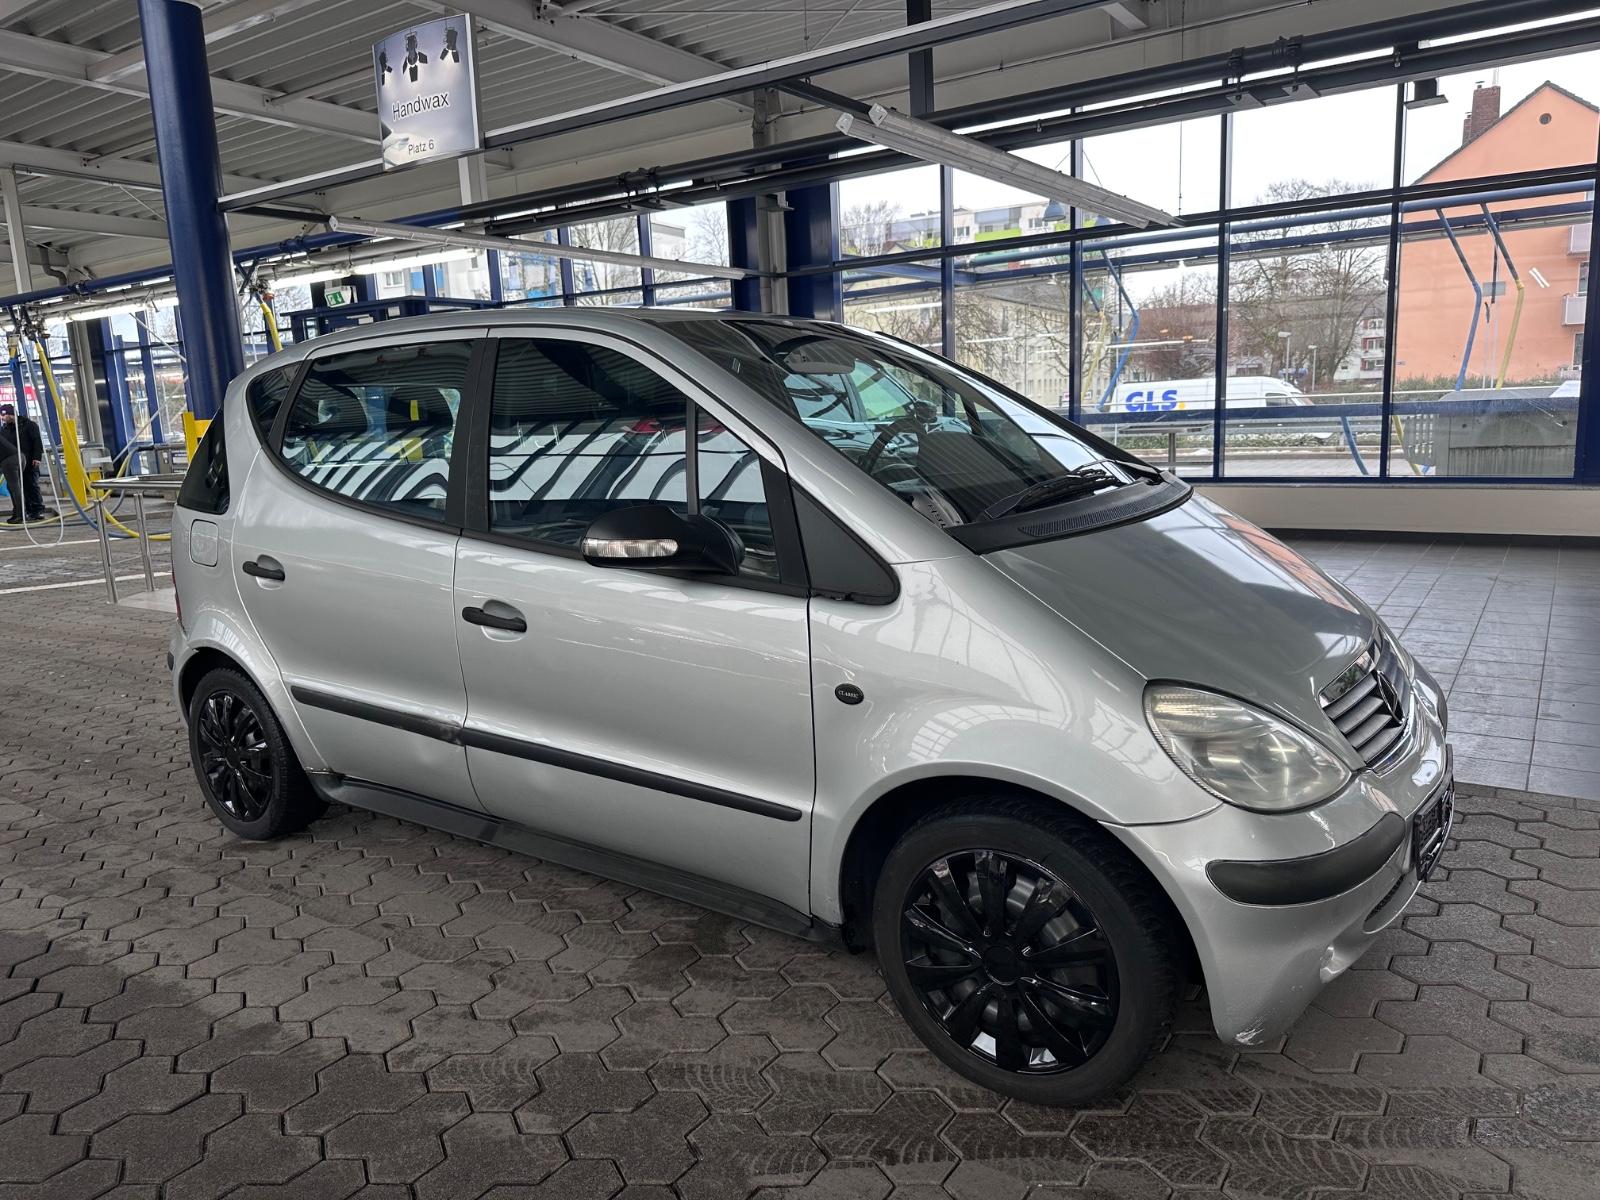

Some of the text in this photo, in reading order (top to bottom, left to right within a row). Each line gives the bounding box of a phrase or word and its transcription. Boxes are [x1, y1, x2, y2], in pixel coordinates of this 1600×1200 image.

[392, 93, 449, 120] Handwax
[408, 139, 435, 155] Platz 6
